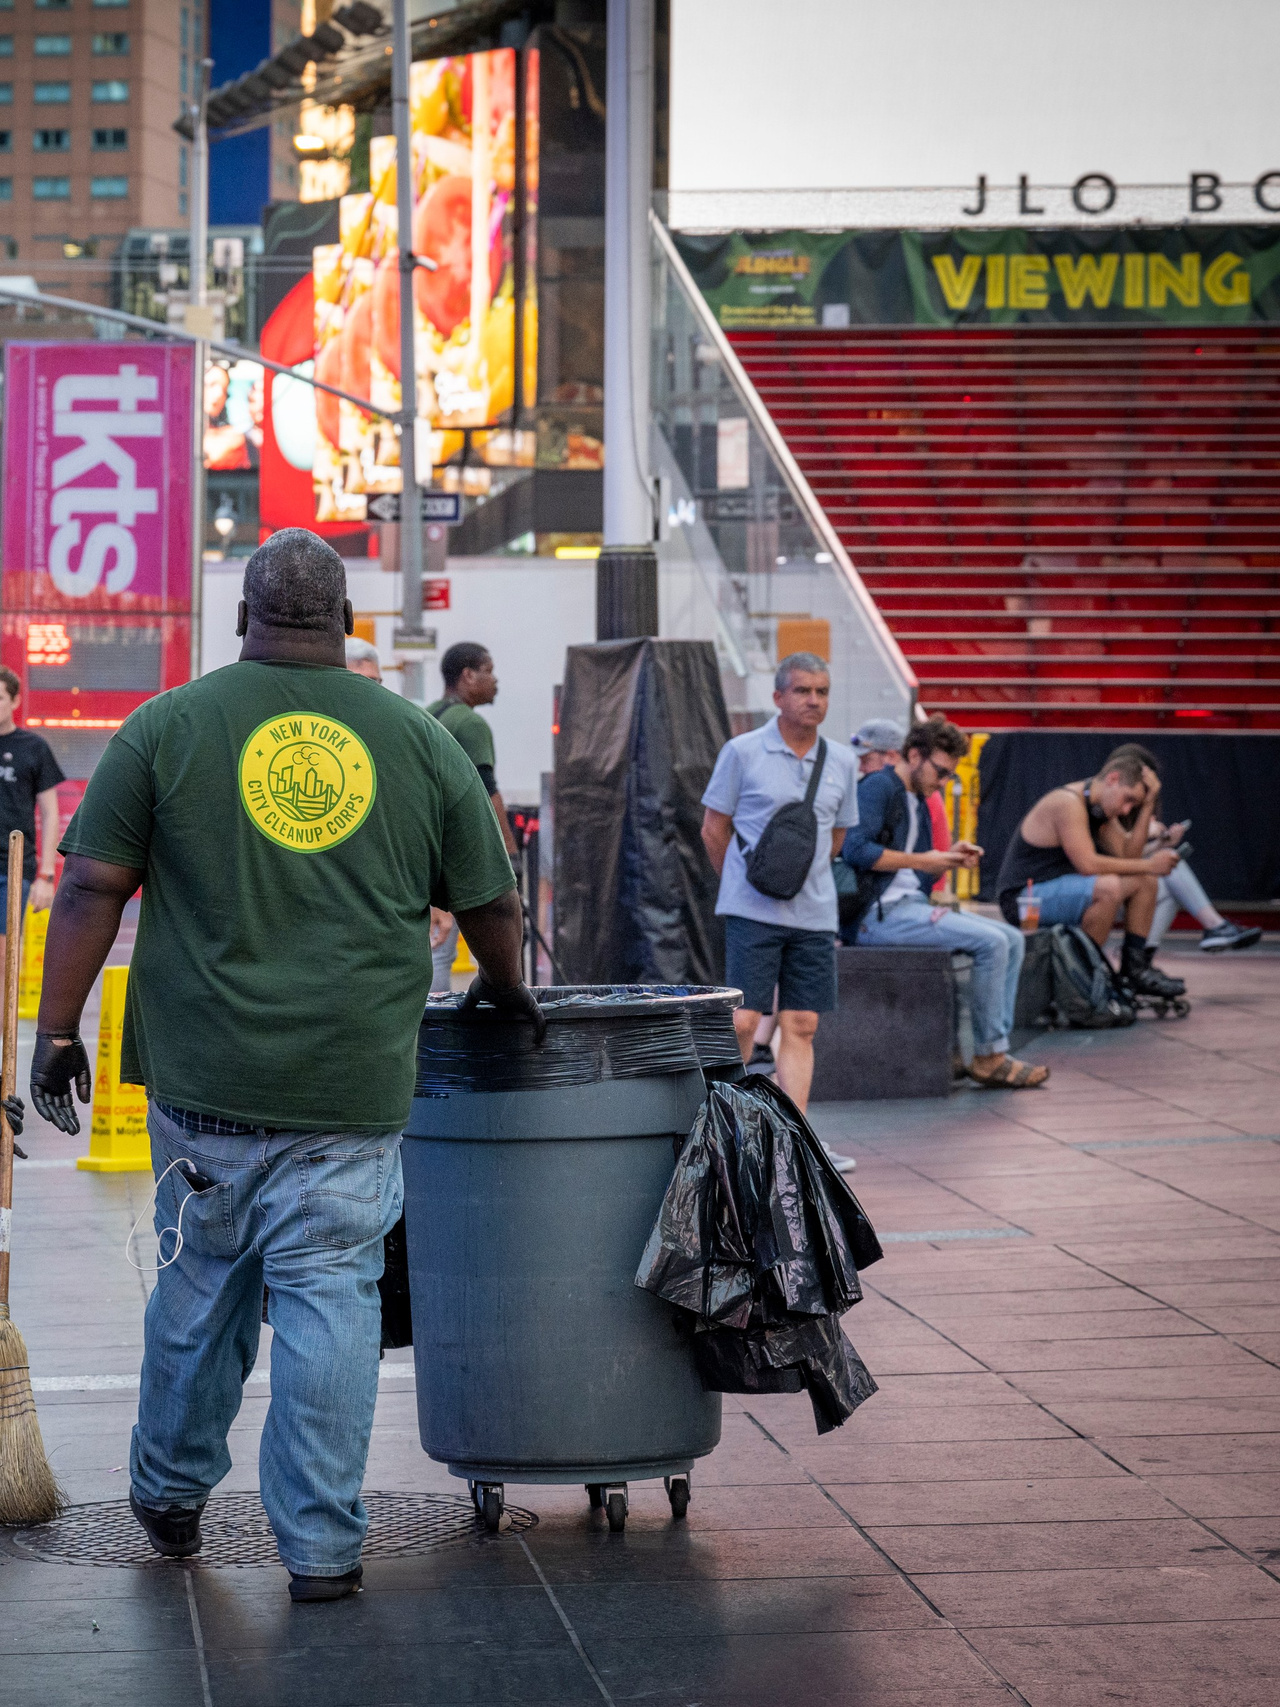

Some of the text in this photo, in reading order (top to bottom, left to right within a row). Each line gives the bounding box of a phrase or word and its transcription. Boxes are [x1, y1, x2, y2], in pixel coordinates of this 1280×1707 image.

[962, 173, 1117, 216] JLO
[931, 252, 1251, 310] VIEWING
[48, 363, 163, 598] tkts
[269, 720, 351, 753] NEW YORK
[247, 780, 365, 843] CITY CLEANUP CORPS
